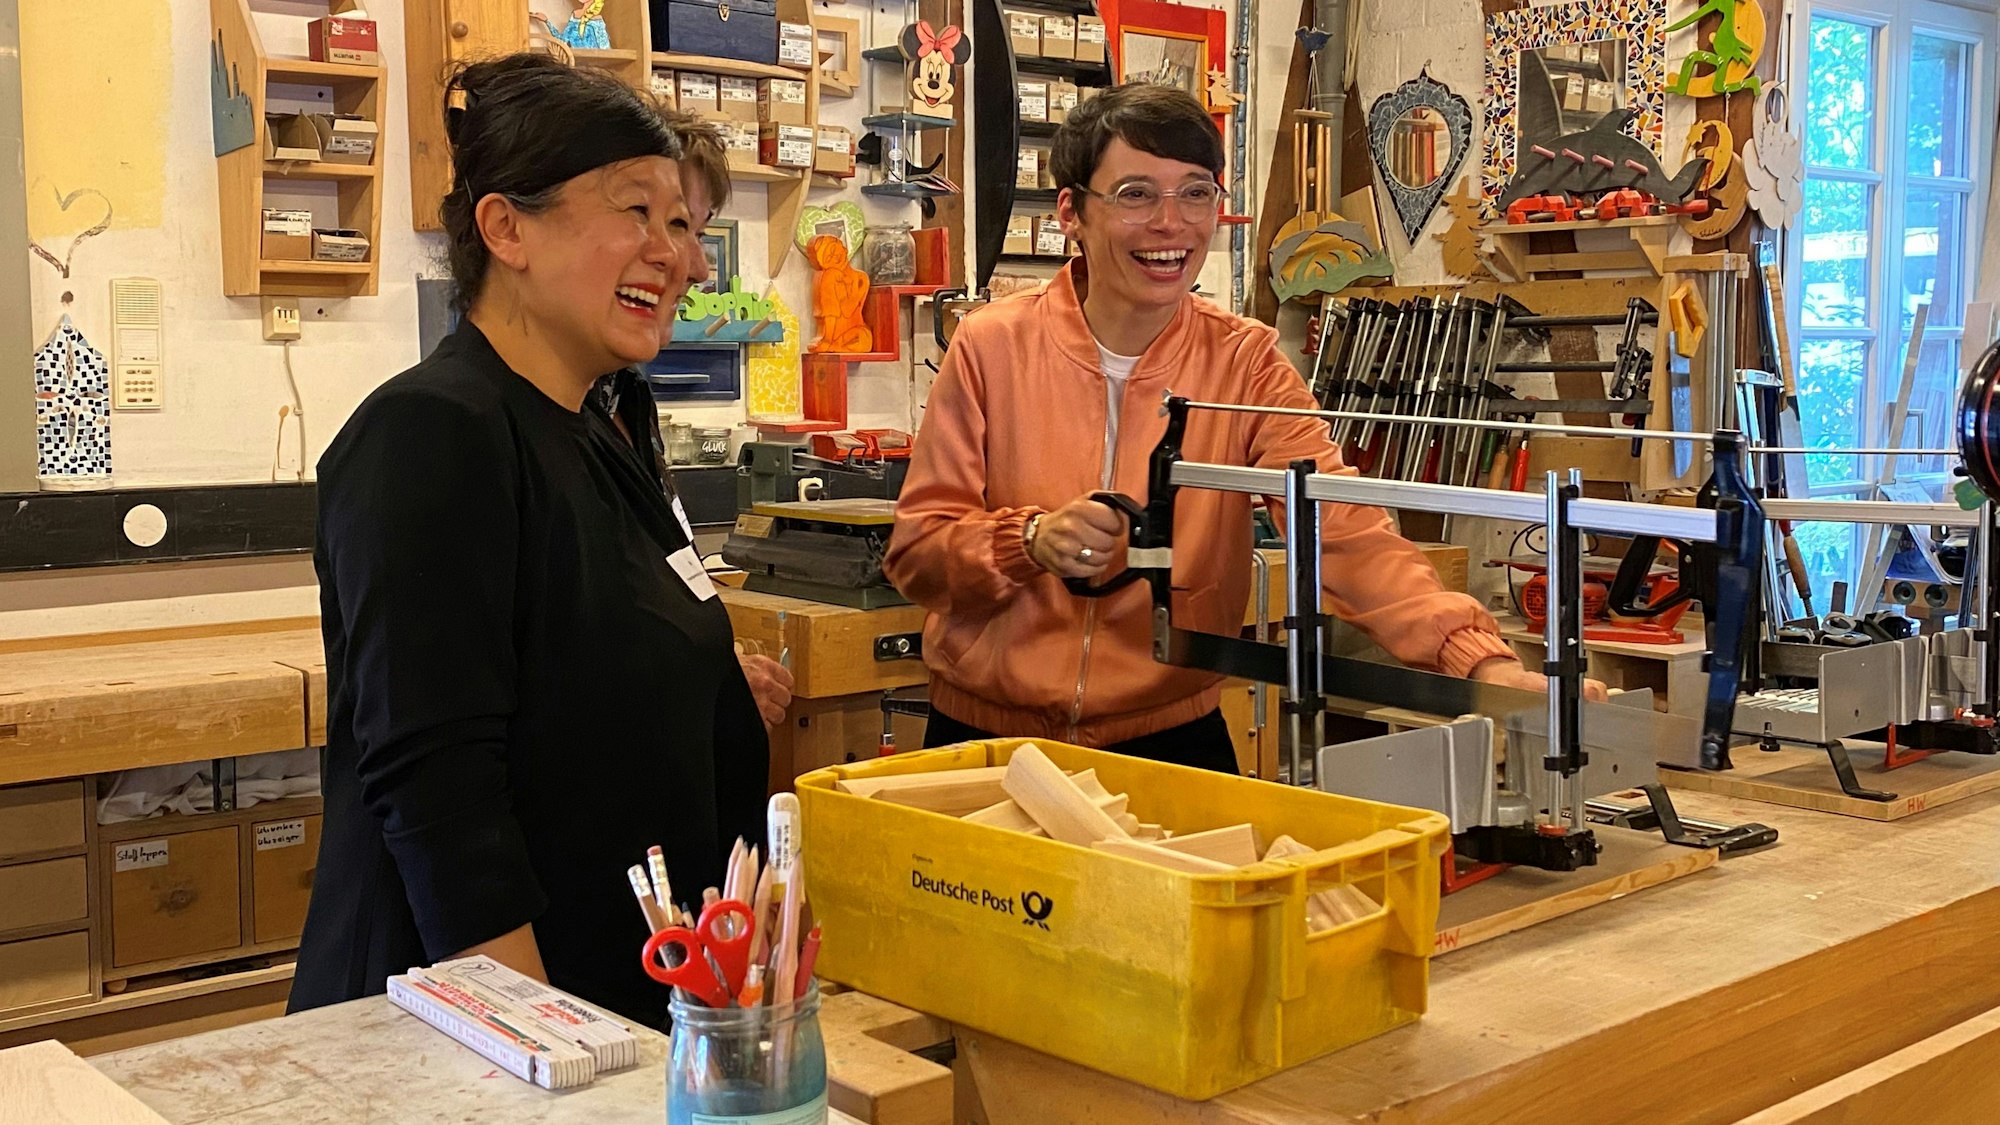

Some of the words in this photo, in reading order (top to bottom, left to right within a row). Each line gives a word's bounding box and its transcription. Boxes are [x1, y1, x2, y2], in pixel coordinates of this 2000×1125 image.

[677, 275, 777, 324] Sophie
[1907, 794, 1927, 813] HW
[912, 870, 979, 905] Deutsche
[982, 889, 1015, 915] Post
